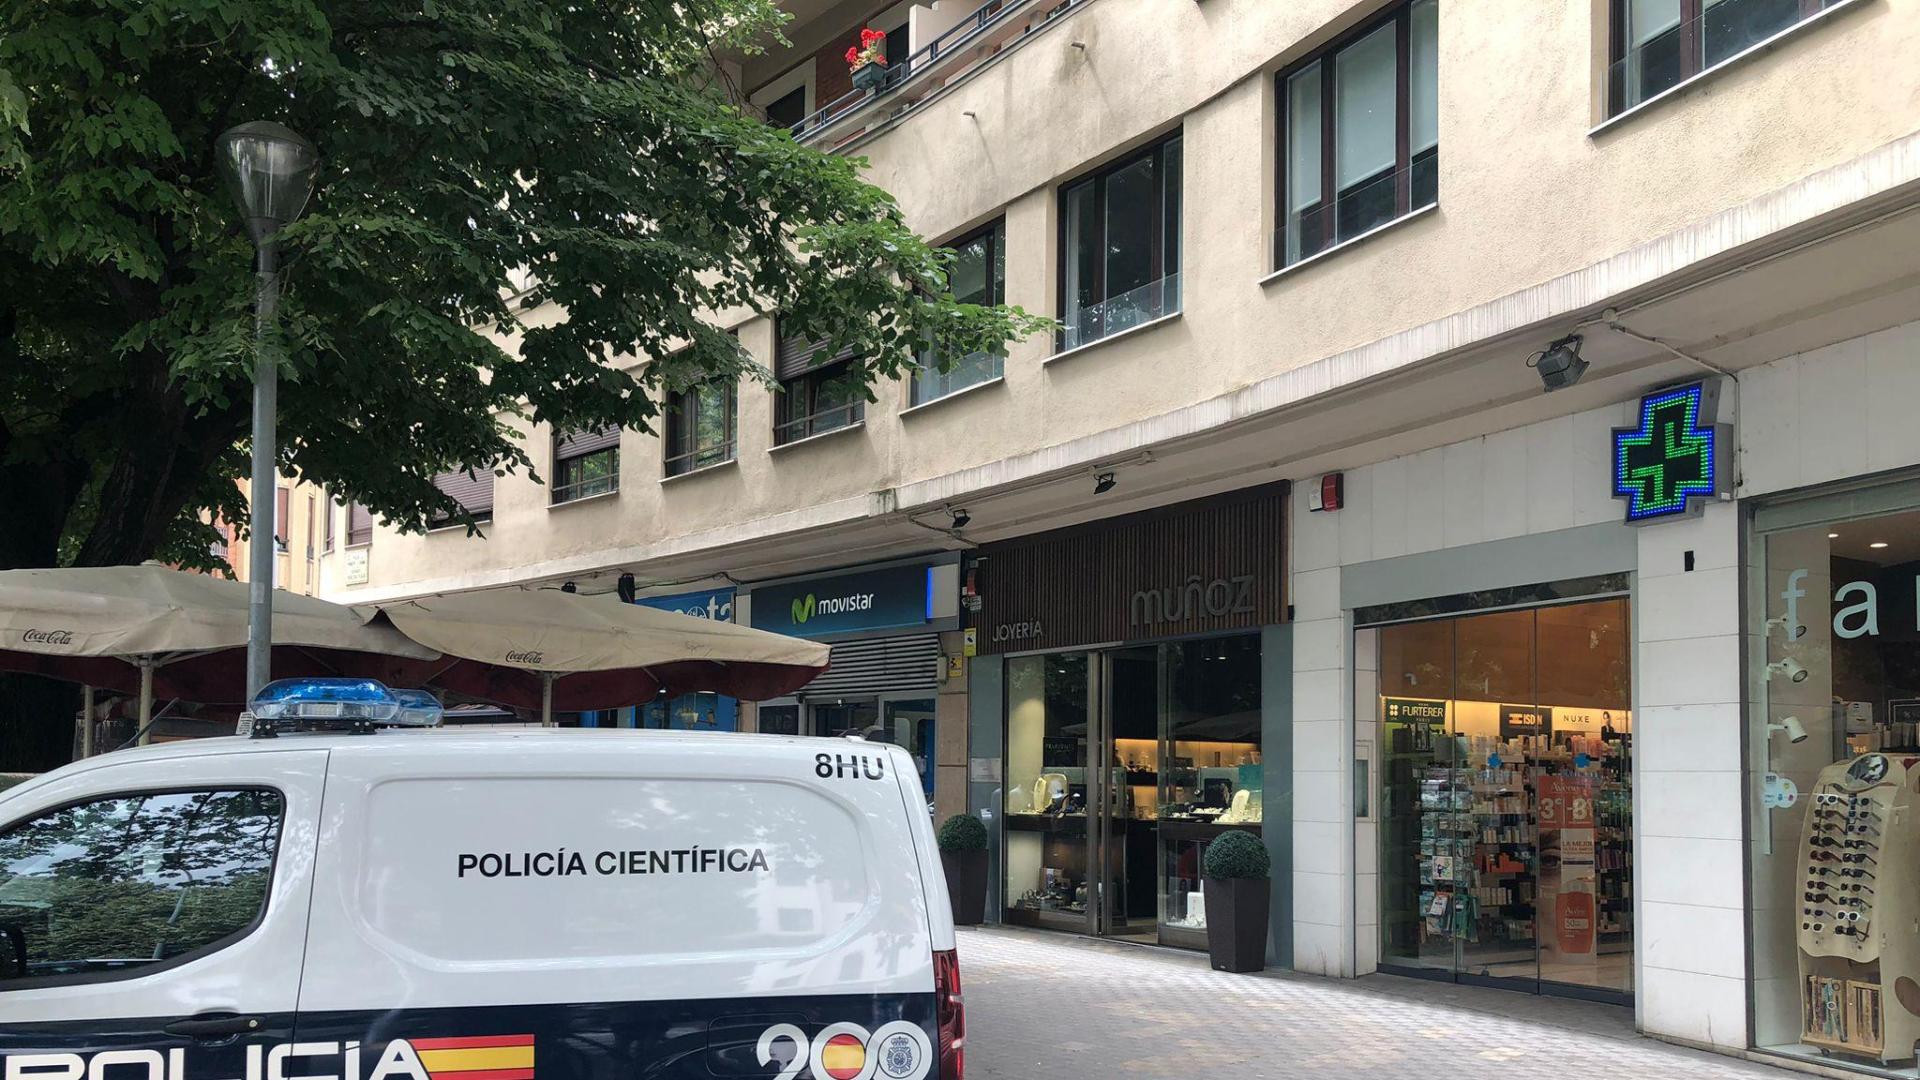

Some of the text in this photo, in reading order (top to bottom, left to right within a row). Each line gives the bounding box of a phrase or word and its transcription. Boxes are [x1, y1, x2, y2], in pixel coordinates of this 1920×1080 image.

[818, 593, 874, 615] movistar
[1781, 568, 1920, 641] fa
[992, 617, 1043, 642] JOYERÍA
[1402, 705, 1444, 718] FURTERER
[1523, 713, 1543, 725] ISDN
[1563, 714, 1590, 723] NUXE
[815, 753, 884, 780] 8HU
[458, 845, 770, 877] POLICÍA CIENTÍFICA
